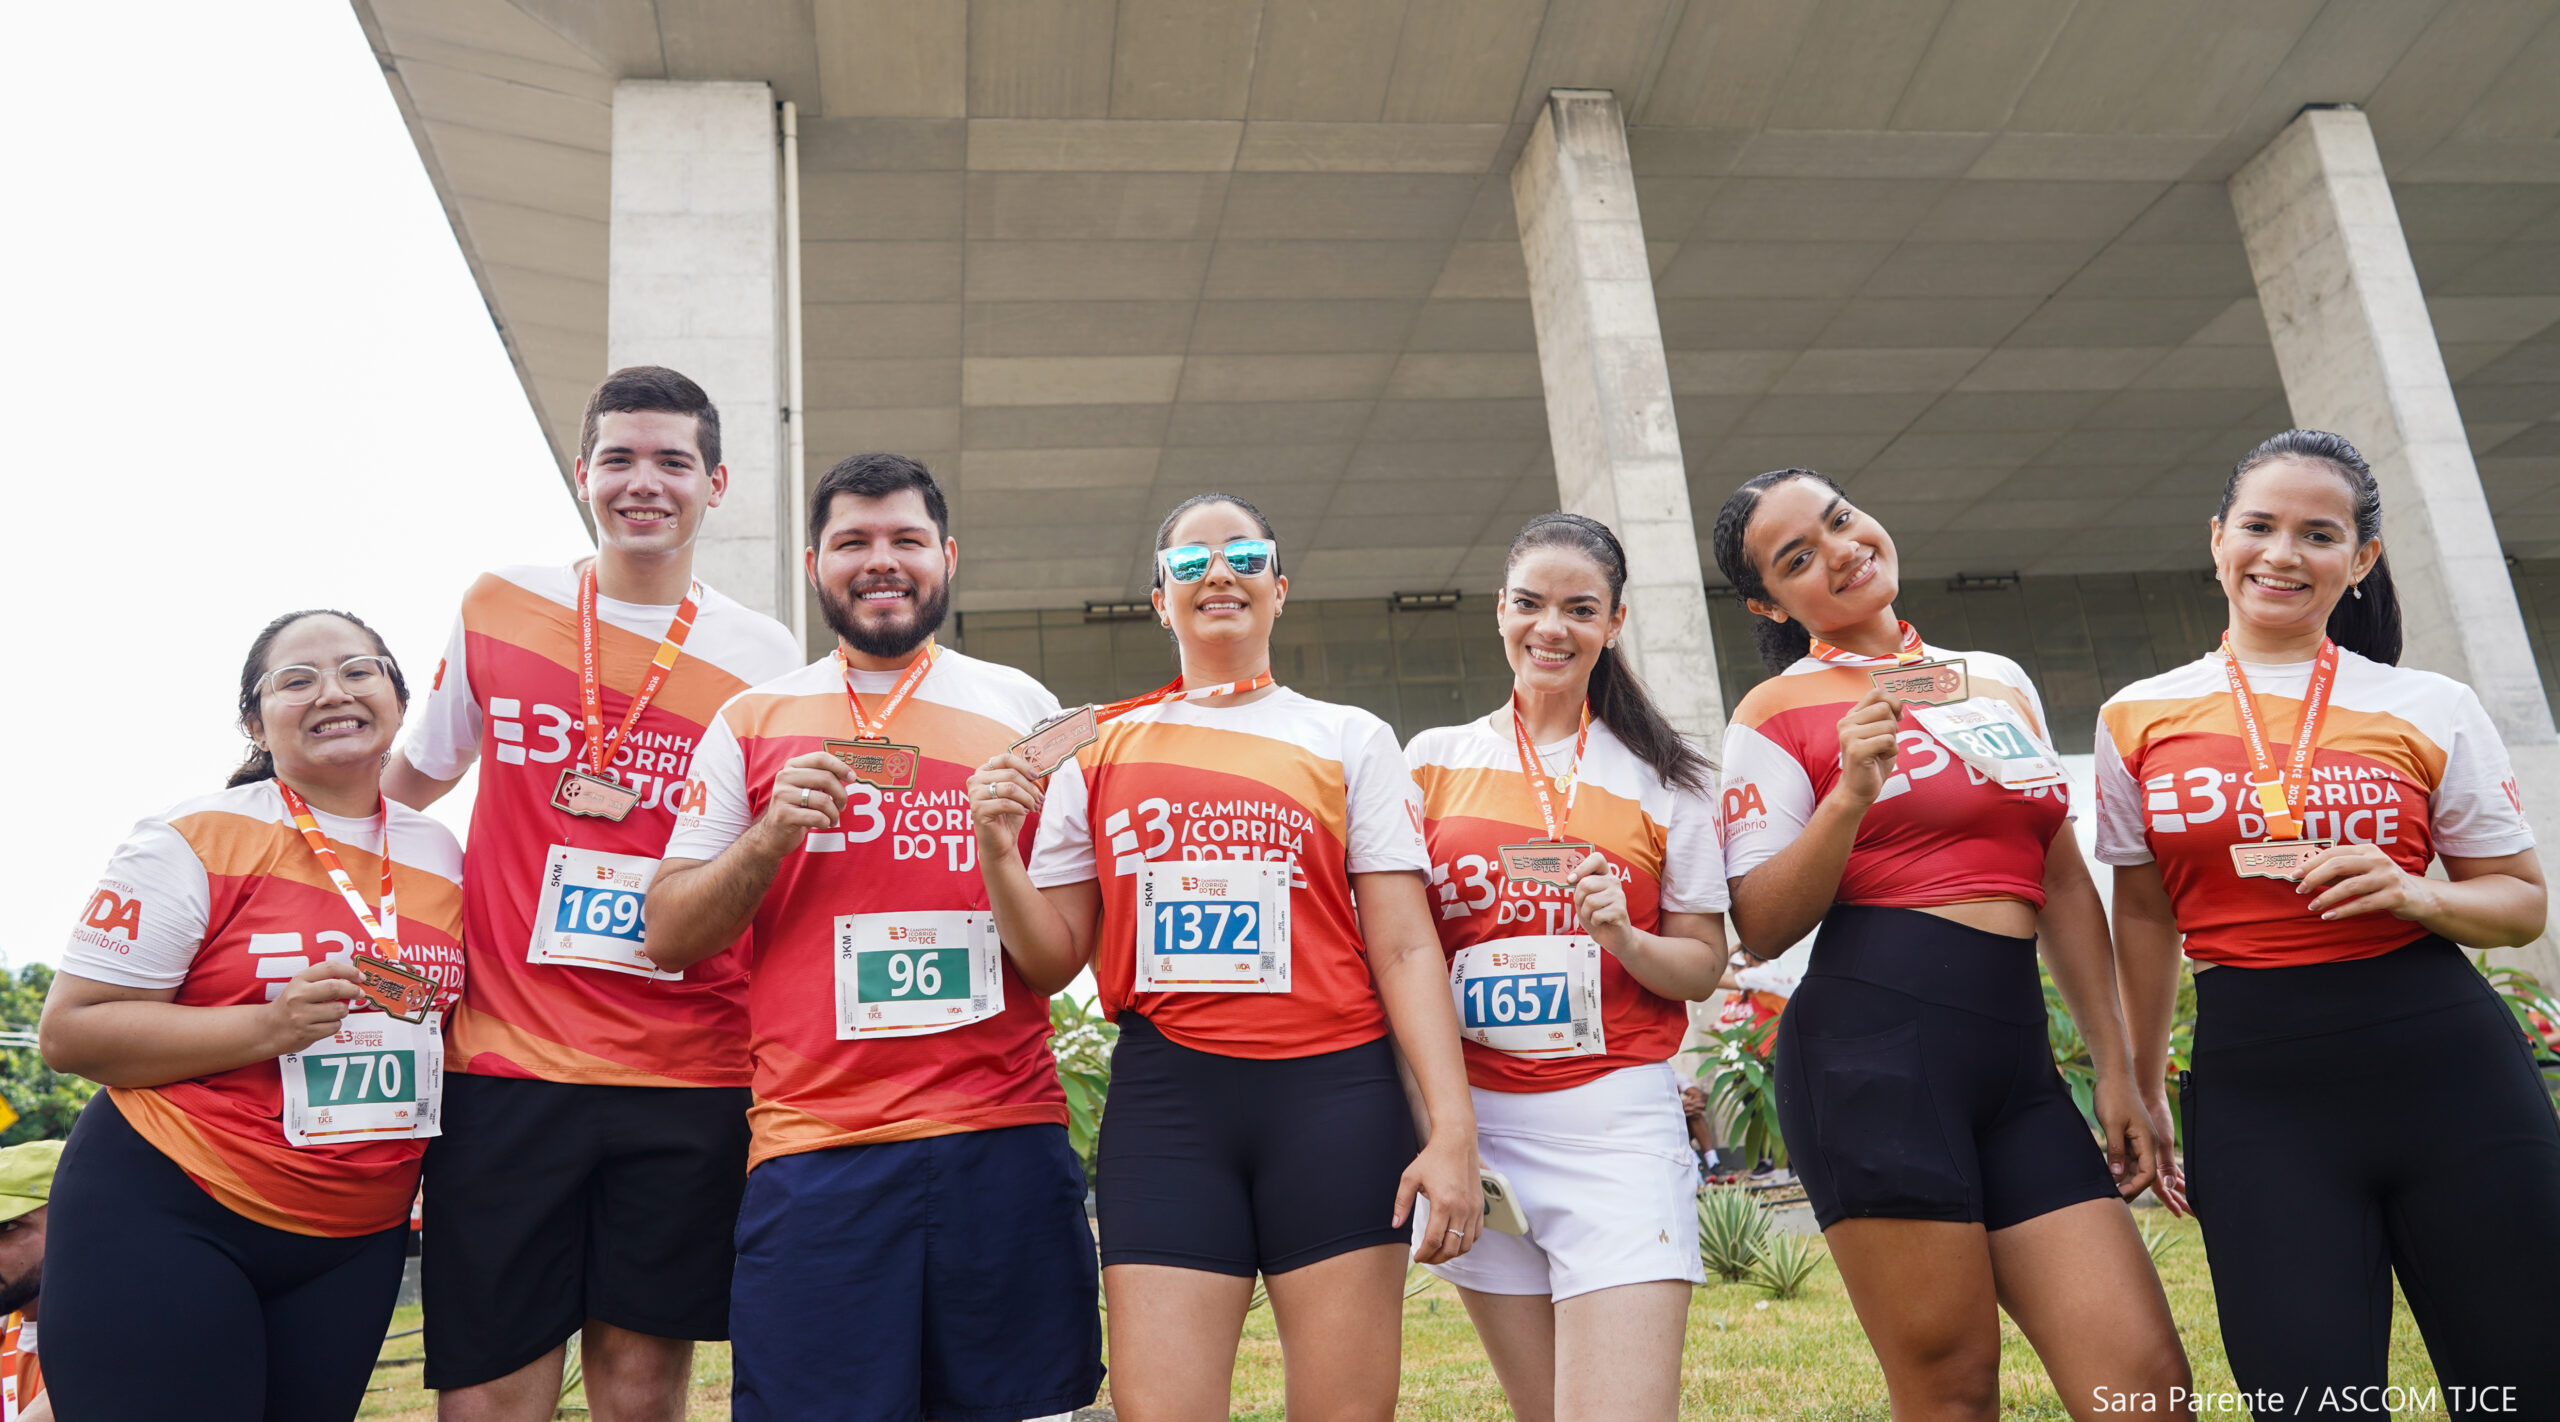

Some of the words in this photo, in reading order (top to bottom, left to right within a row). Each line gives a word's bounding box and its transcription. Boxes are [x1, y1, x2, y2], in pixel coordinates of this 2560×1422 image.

[584, 652, 593, 666] DO
[2232, 677, 2243, 689] DO
[528, 703, 584, 764] 3ª
[1957, 724, 2023, 758] 807
[2294, 749, 2306, 762] DO
[626, 772, 686, 816] TJC
[2183, 767, 2237, 824] 3ª
[2235, 781, 2402, 812] /CRRIDA
[2287, 783, 2300, 806] 2026
[846, 782, 895, 843] 3ª
[901, 789, 970, 808] CAMIN
[1137, 797, 1182, 859] 3ª
[1188, 799, 1314, 834] CAMINHADA
[1180, 819, 1303, 855] /CORRIDA
[2304, 808, 2399, 846] TJCE
[893, 833, 937, 861] DO
[941, 835, 980, 872] TJ
[551, 863, 563, 888] 5KM
[623, 879, 640, 889] TJCE
[1456, 854, 1498, 910] 3ª
[1145, 882, 1154, 907] 5KM
[1208, 888, 1227, 896] TJCE
[1497, 899, 1535, 925] DO
[918, 936, 936, 945] TJCE
[1158, 904, 1258, 950] 1372
[371, 943, 466, 967] CMINHAD
[842, 935, 852, 959] 3KM
[888, 951, 942, 997] 96
[1455, 963, 1465, 985] 5KM
[1519, 962, 1536, 970] TJCE
[1467, 975, 1566, 1024] 1657
[365, 1039, 383, 1047] TJCE
[320, 1054, 402, 1101] 770
